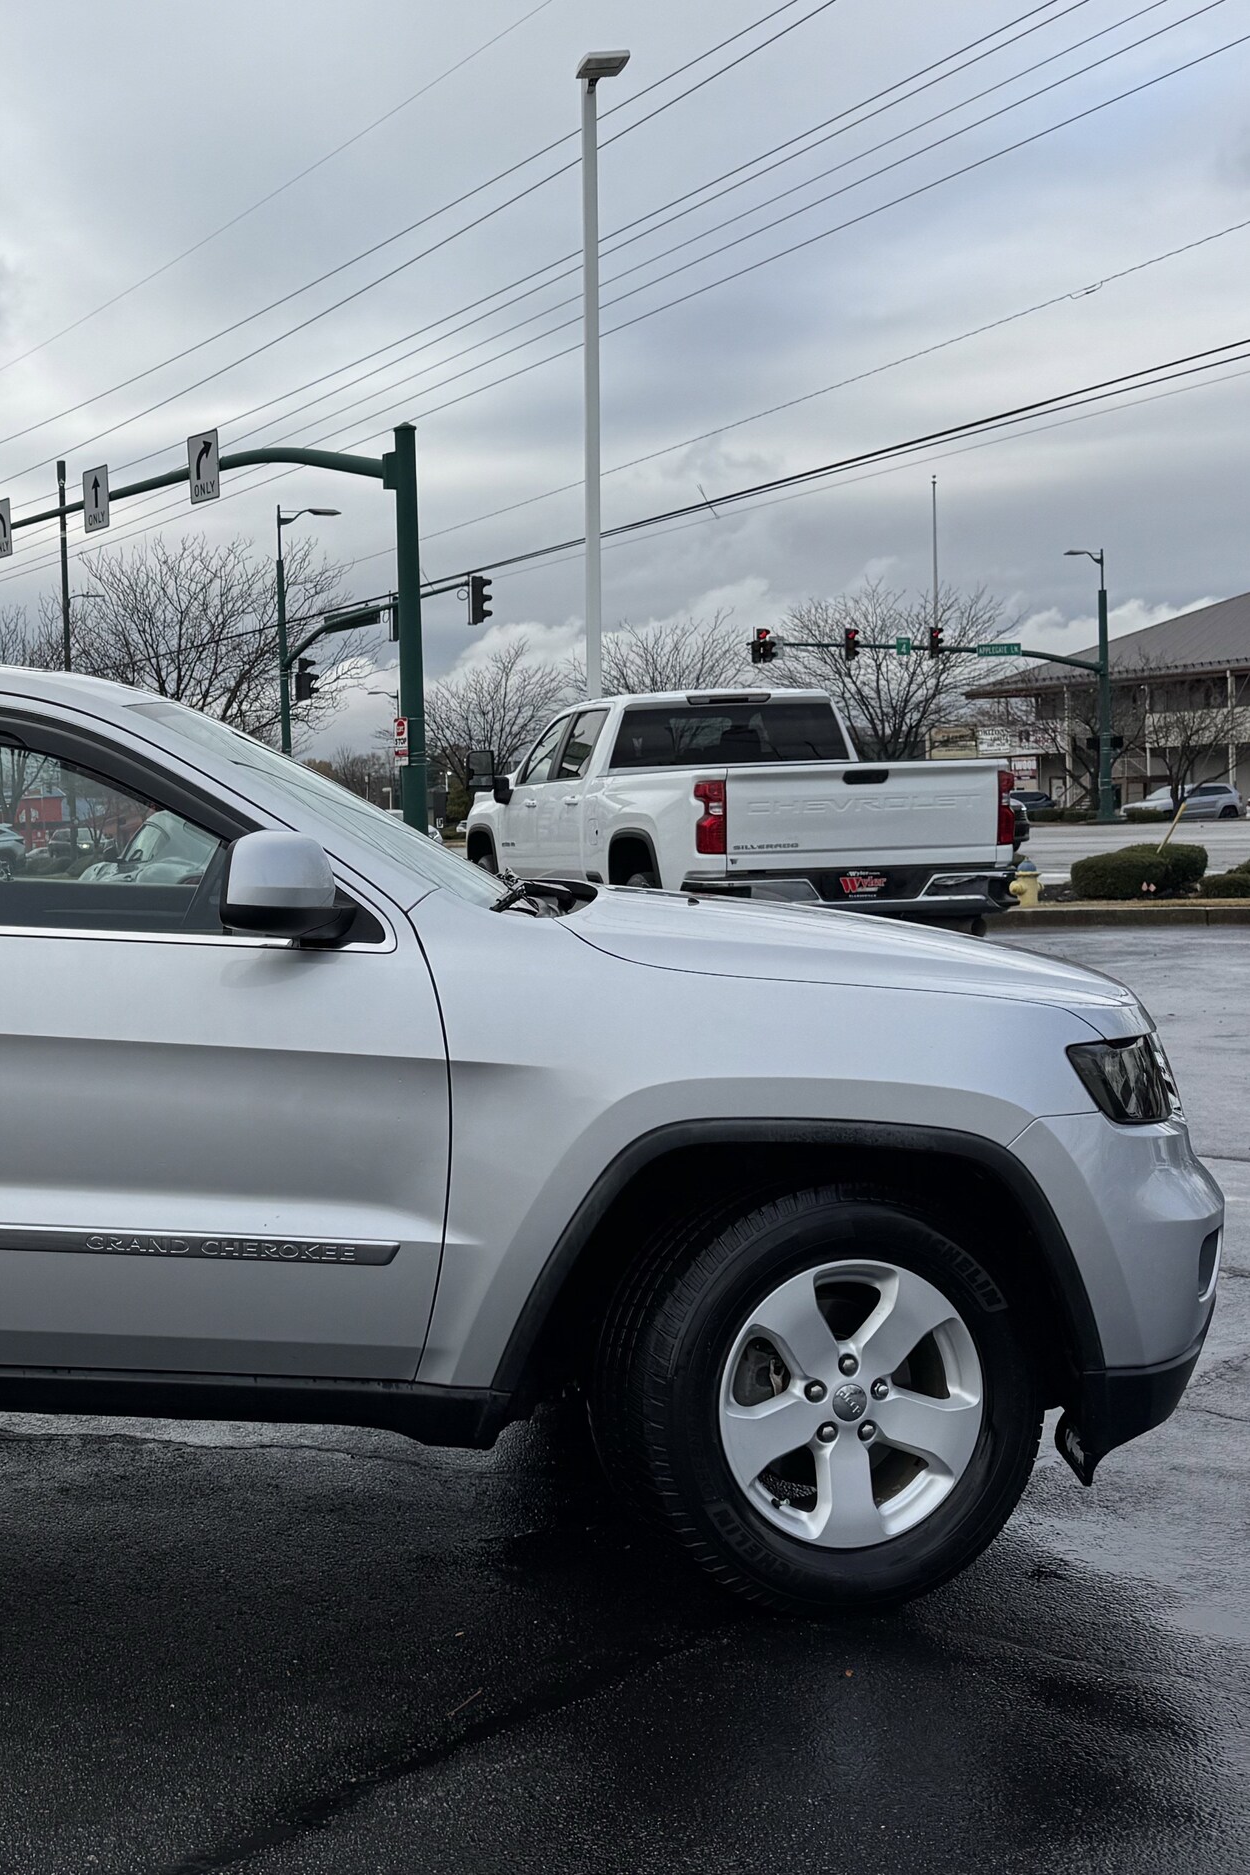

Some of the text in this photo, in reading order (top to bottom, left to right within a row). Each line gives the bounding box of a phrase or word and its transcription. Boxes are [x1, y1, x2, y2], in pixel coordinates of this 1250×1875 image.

[193, 482, 216, 498] ONLY
[88, 511, 106, 527] ONLY
[747, 793, 981, 816] CHEVROLET
[839, 876, 887, 893] Wyler
[85, 1235, 356, 1262] GRAND CHEROKEE
